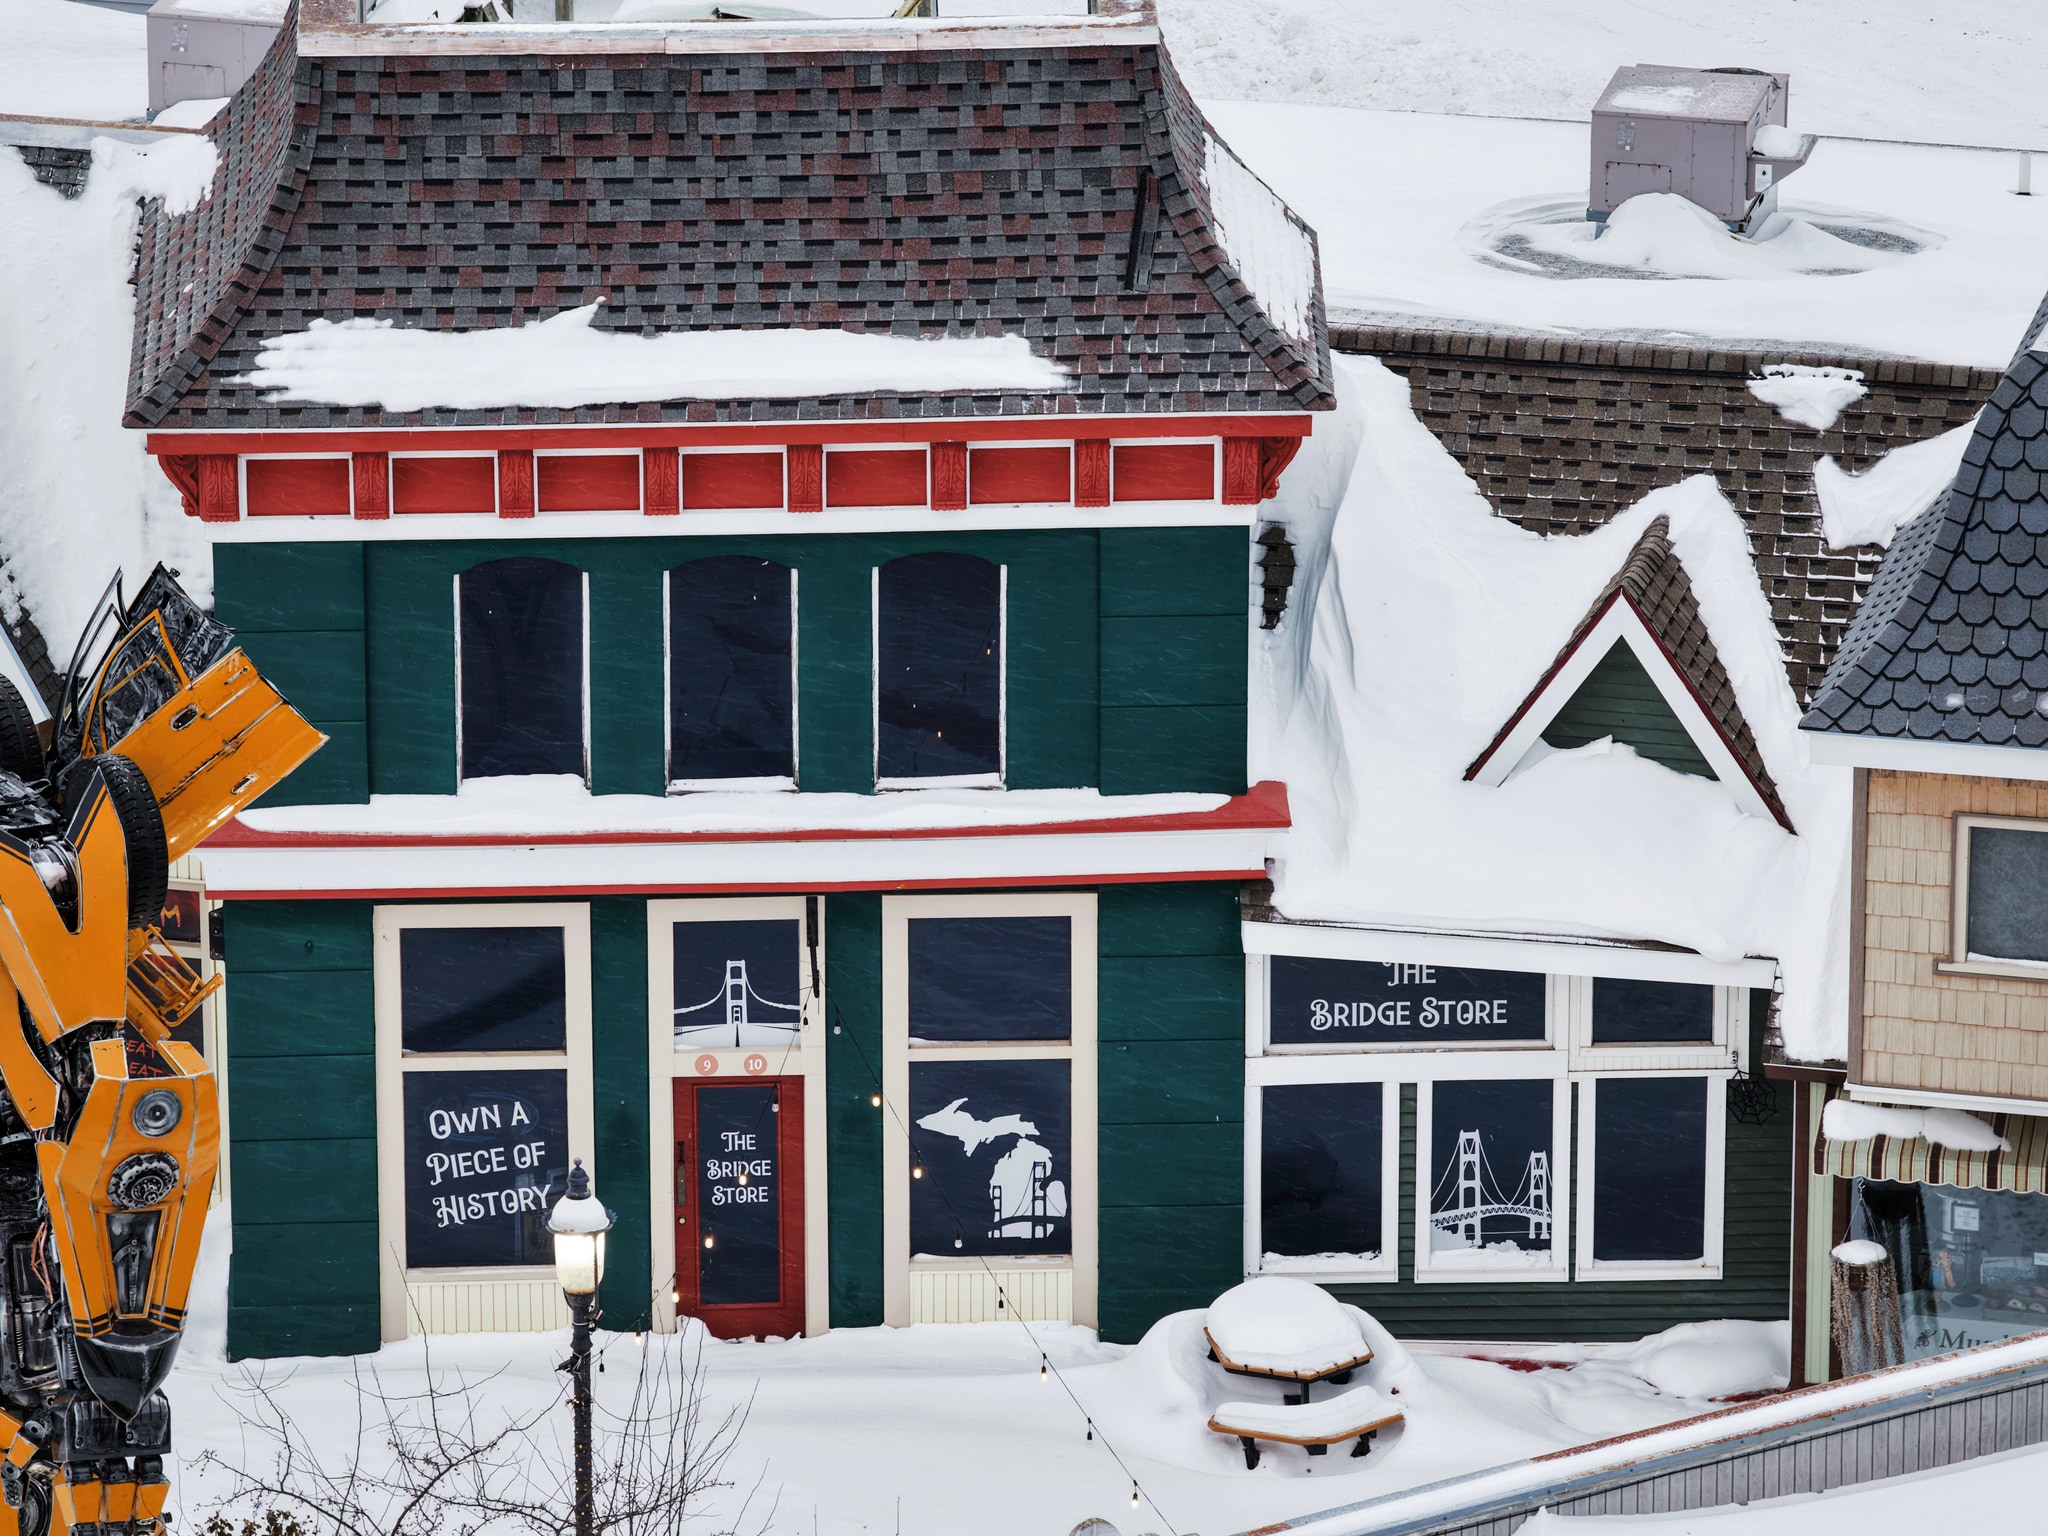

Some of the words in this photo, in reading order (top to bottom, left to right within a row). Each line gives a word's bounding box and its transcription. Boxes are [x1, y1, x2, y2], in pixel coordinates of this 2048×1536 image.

[1382, 961, 1437, 987] THE
[1310, 999, 1411, 1031] BRIDGE
[1418, 996, 1508, 1028] STORE
[703, 1059, 712, 1072] 9
[748, 1058, 763, 1071] 10
[429, 1104, 502, 1140] OWN
[510, 1101, 530, 1126] A
[720, 1131, 757, 1153] THE
[425, 1146, 508, 1186] PIECE
[513, 1141, 546, 1169] OF
[706, 1159, 772, 1180] BRIDGE
[432, 1184, 551, 1228] HISTORY
[711, 1185, 769, 1206] STORE
